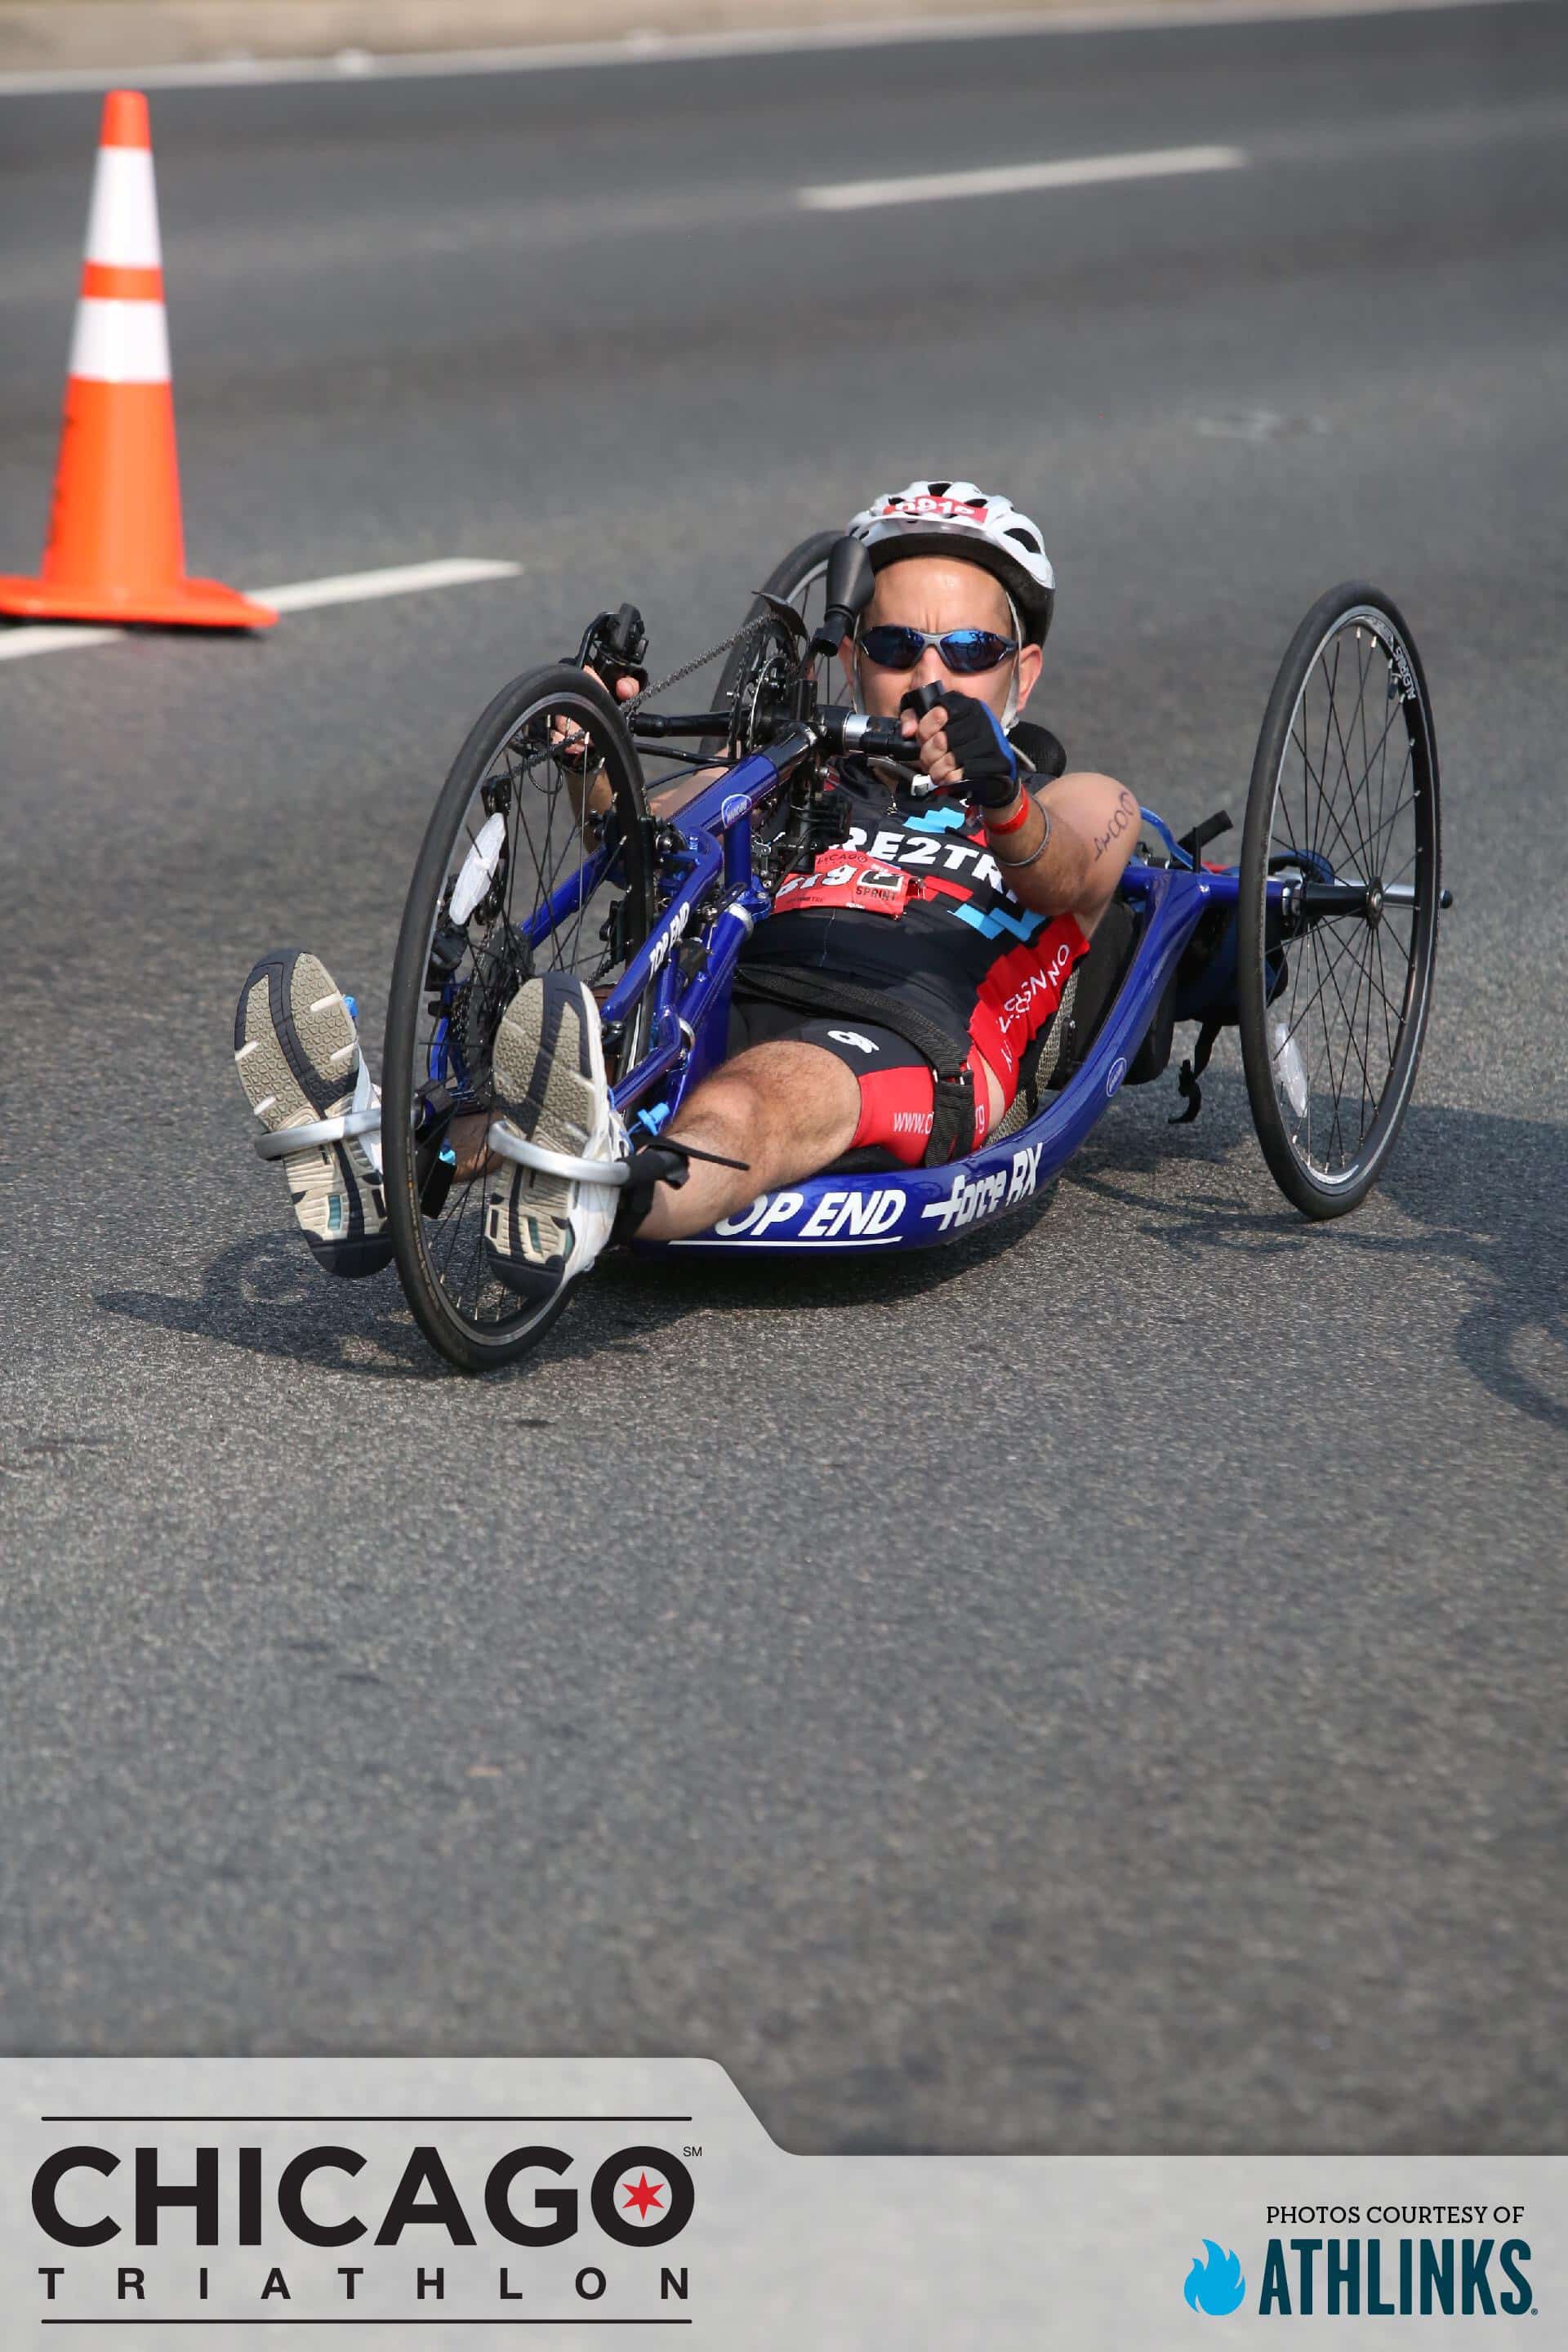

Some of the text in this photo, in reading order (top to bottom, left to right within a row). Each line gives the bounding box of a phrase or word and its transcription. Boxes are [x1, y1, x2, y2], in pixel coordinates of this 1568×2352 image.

[828, 826, 1019, 904] RE2TR
[1005, 1142, 1043, 1207] RX
[715, 1189, 906, 1236] OP END
